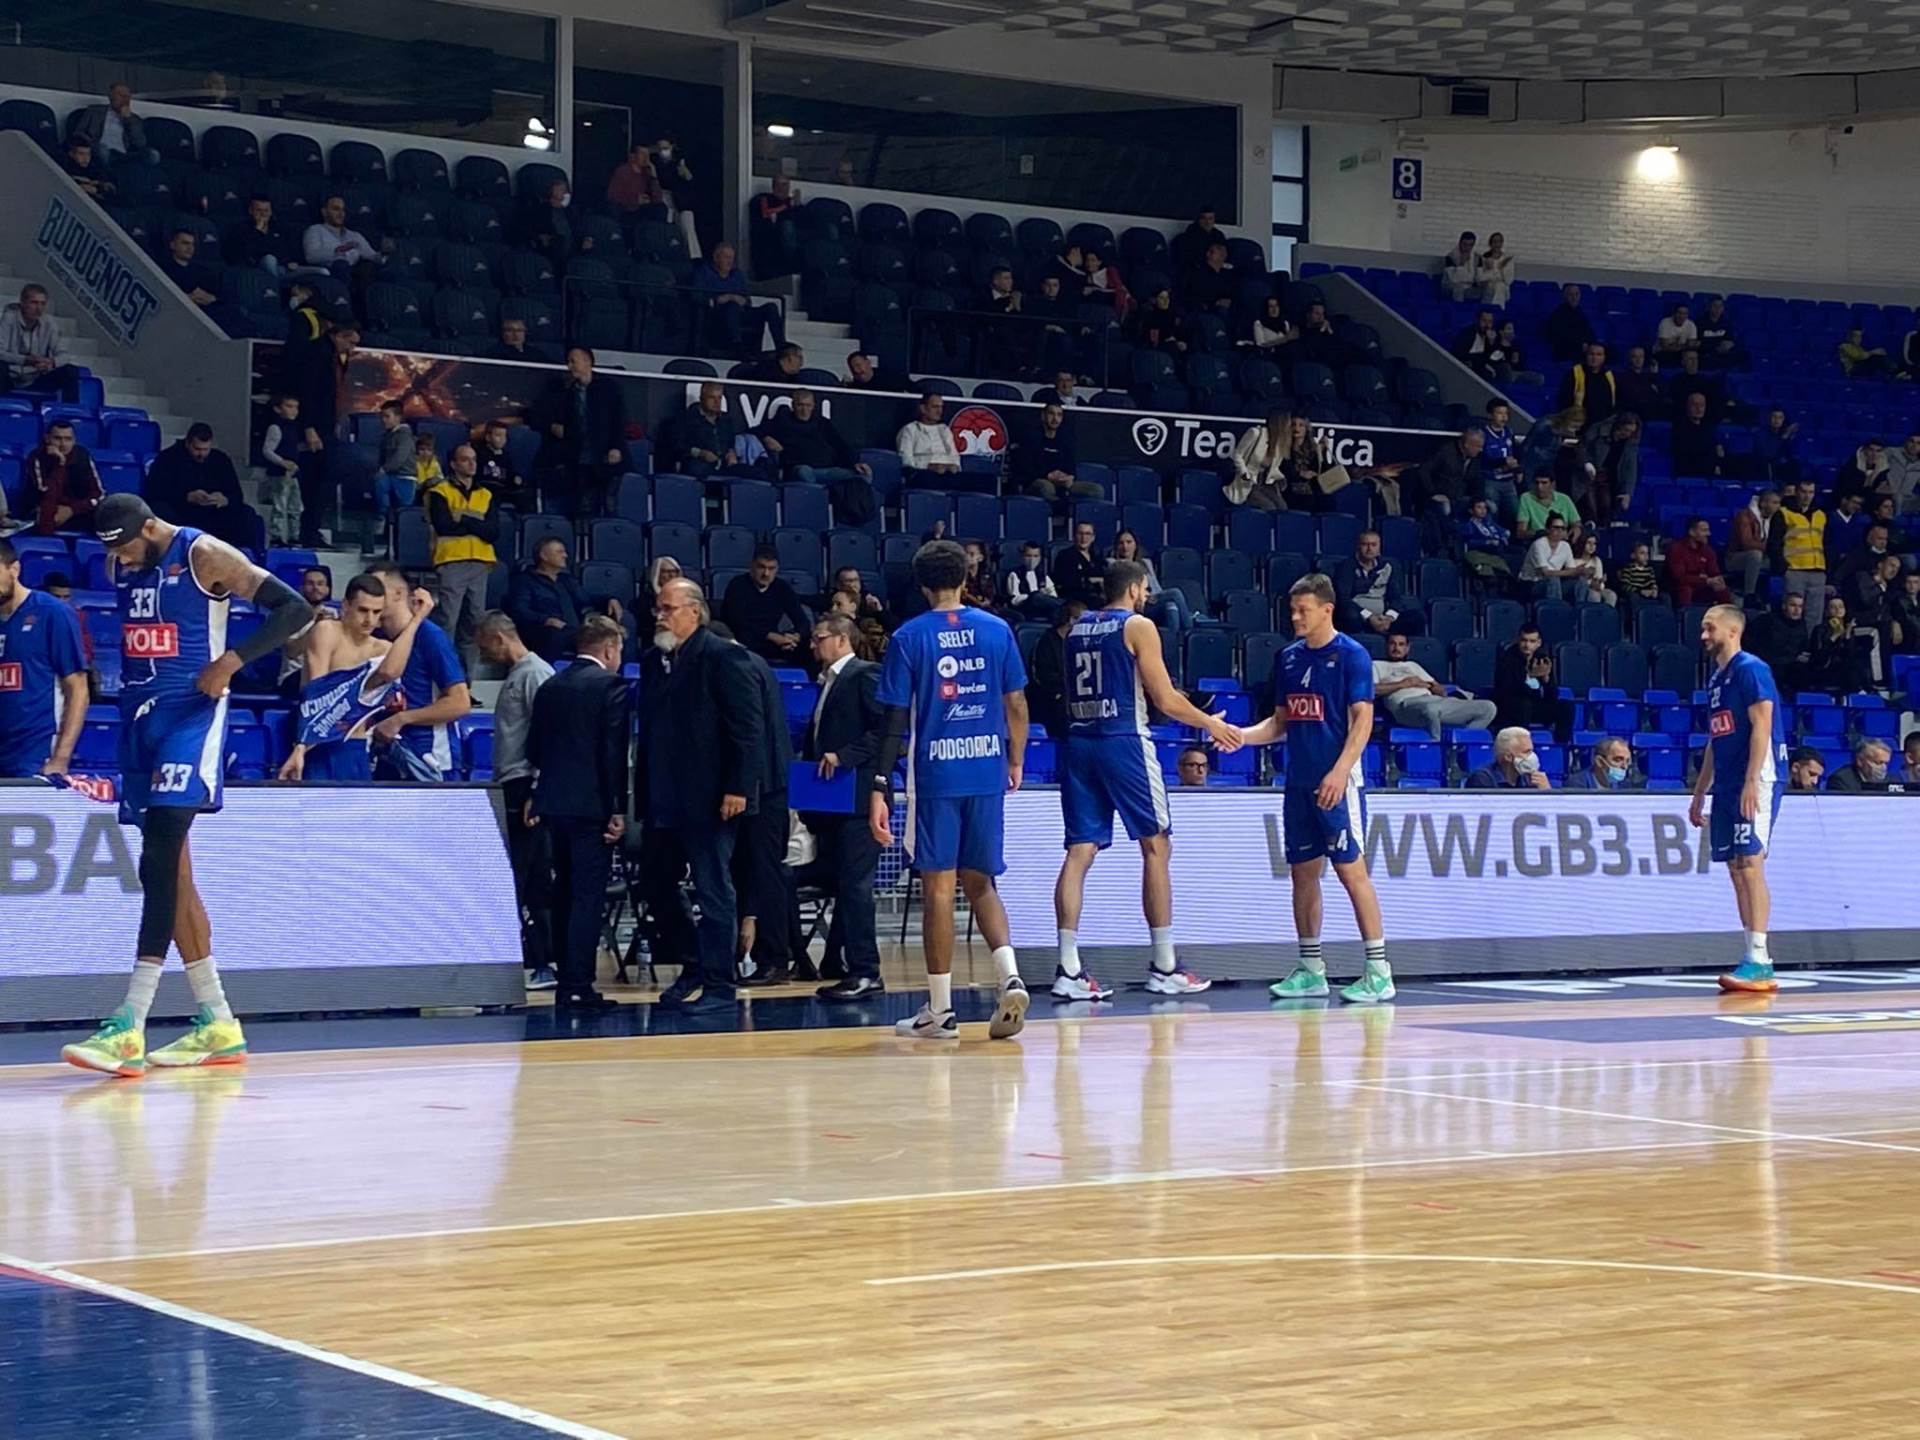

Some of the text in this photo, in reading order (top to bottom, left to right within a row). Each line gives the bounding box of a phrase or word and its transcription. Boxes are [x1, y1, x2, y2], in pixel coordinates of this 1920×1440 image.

[1399, 161, 1416, 188] 8
[1174, 420, 1237, 459] Tea
[129, 588, 156, 618] 33
[937, 629, 975, 649] SEELEY
[959, 657, 985, 671] NLB
[1076, 651, 1102, 696] 21
[1301, 666, 1313, 688] 4
[1287, 698, 1320, 716] VOLI
[929, 734, 1000, 761] PODGORICA
[159, 763, 193, 793] 33
[1264, 813, 1710, 879] WW.GB3.B
[1337, 829, 1348, 851] 4
